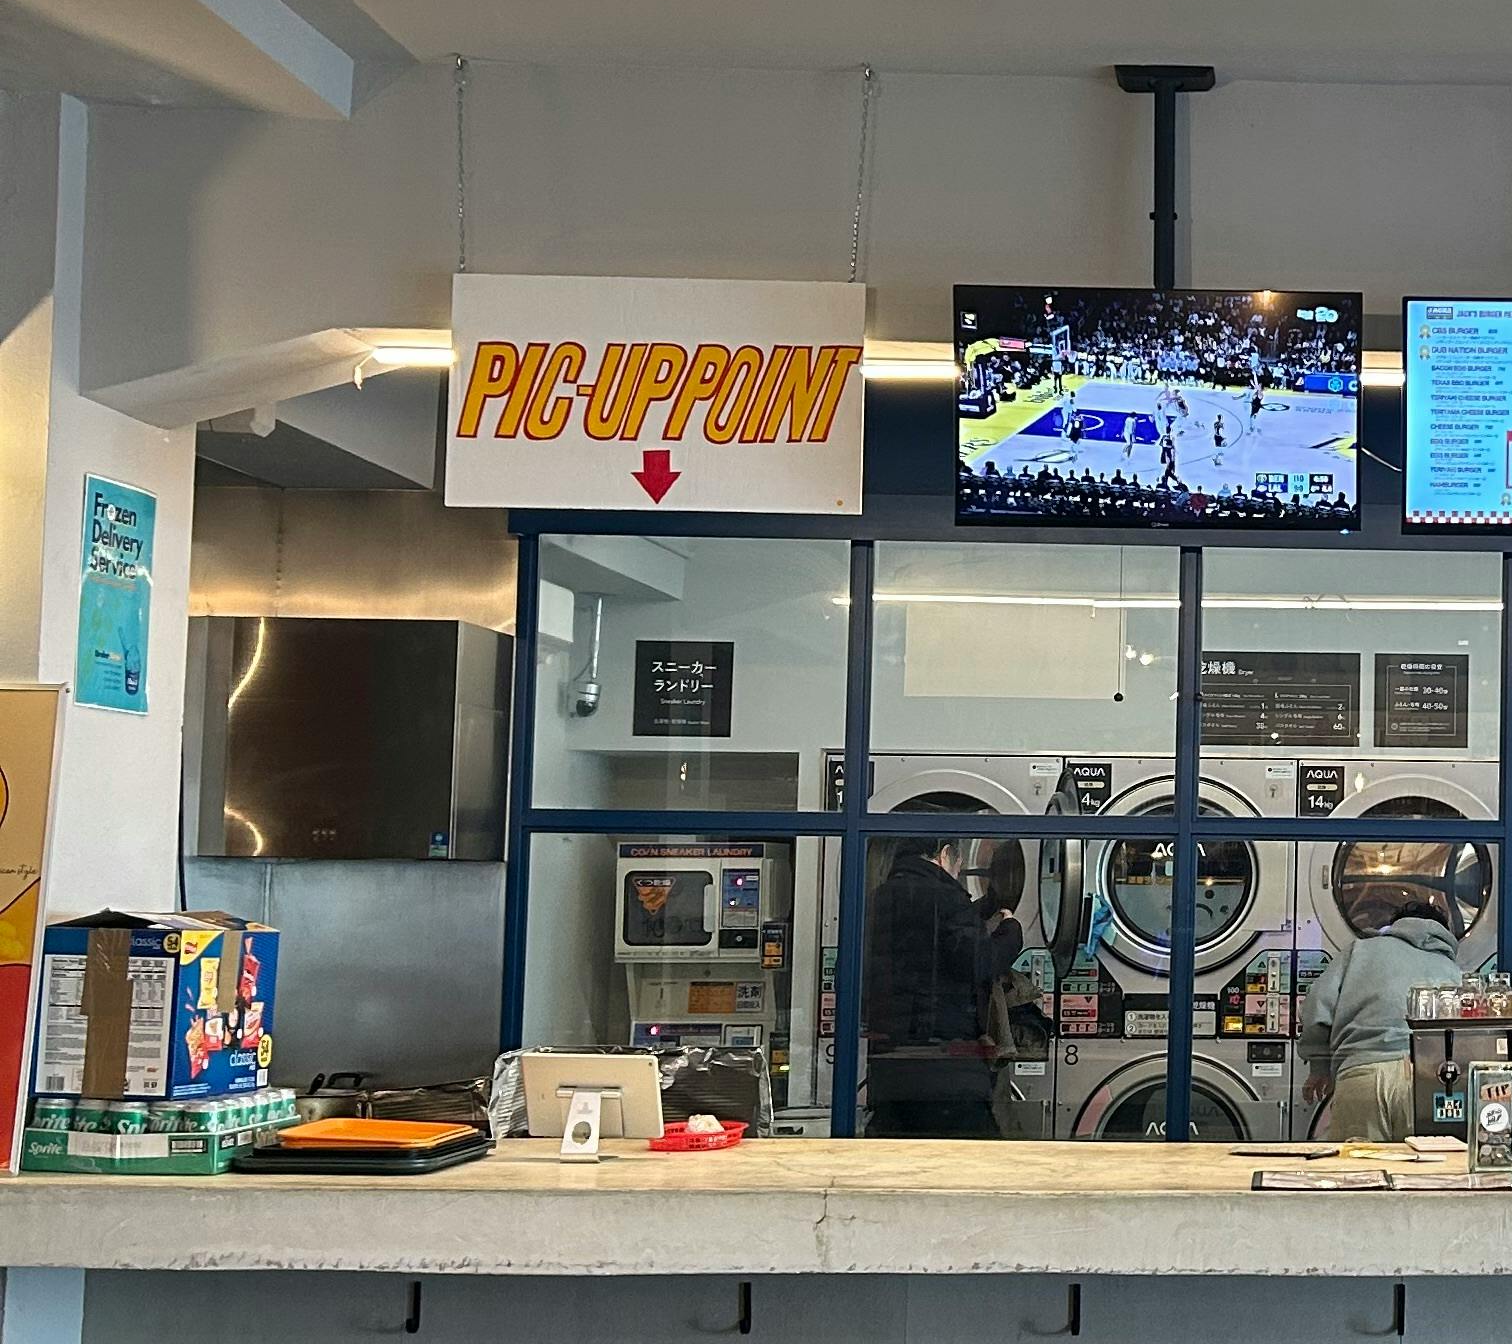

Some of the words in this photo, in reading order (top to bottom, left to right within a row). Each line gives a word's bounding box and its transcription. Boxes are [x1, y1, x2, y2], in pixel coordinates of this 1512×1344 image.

[94, 492, 137, 528] Frozen
[91, 519, 144, 561] Delivery
[90, 547, 138, 580] Service
[652, 661, 717, 674] スニーカー
[654, 679, 714, 693] ランドリー
[1074, 767, 1106, 777] AQUA
[1306, 769, 1338, 779] AQUA
[131, 934, 162, 946] lassic
[1064, 1044, 1079, 1066] 8
[28, 1142, 65, 1155] Sprite
